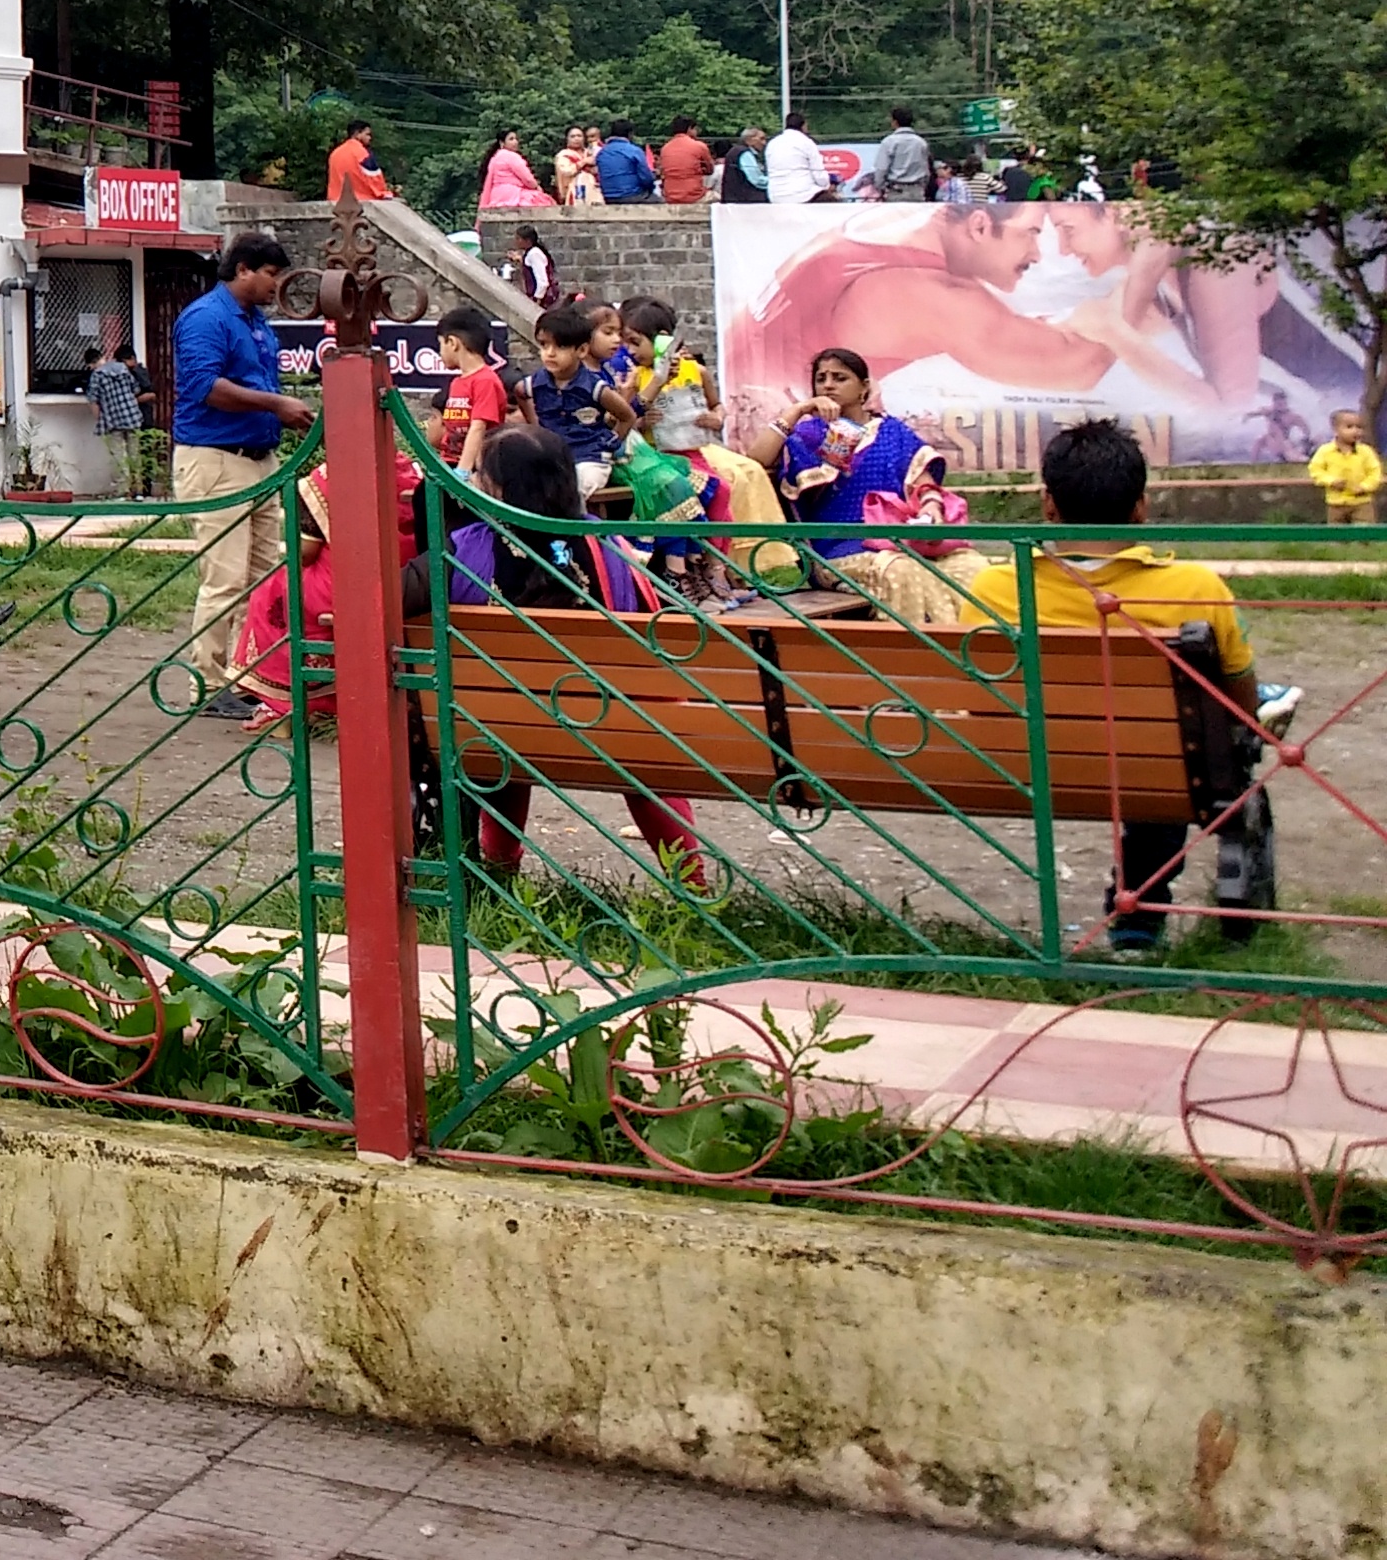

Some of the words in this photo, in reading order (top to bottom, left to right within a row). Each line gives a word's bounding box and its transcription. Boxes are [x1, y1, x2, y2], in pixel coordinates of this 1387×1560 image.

[99, 179, 128, 220] BOX
[129, 180, 177, 223] OFFICE
[278, 346, 314, 374] ew
